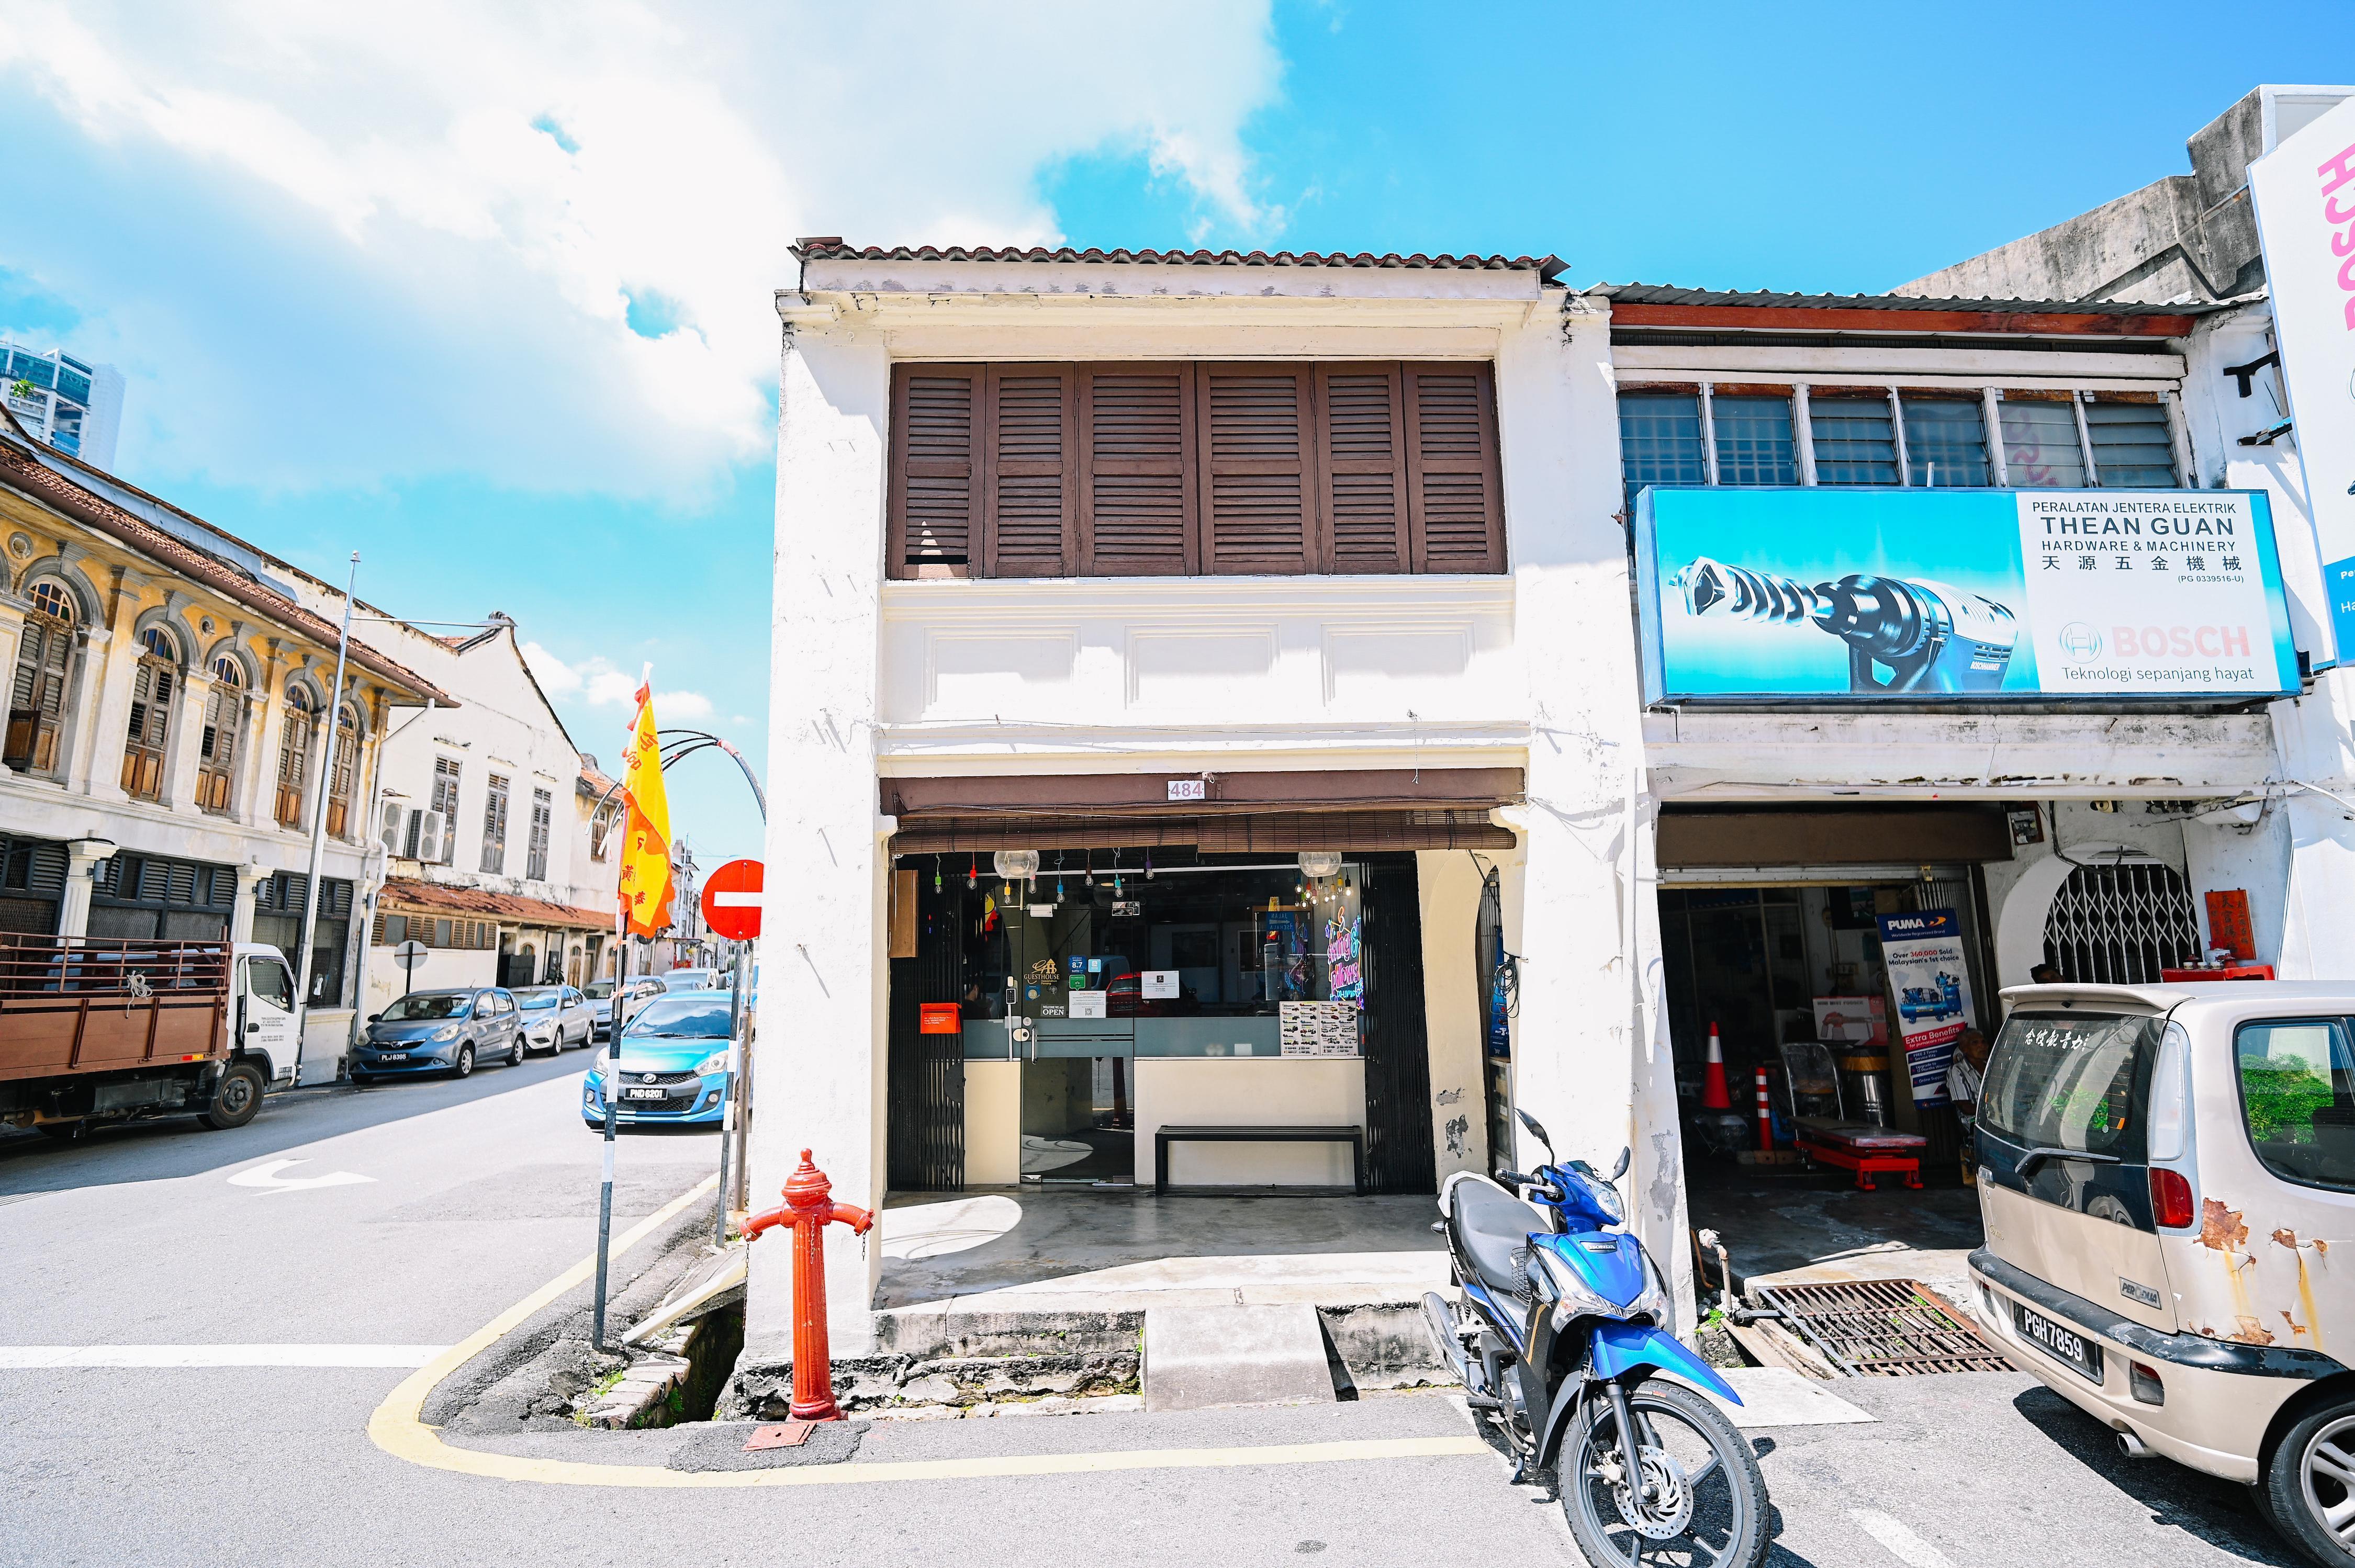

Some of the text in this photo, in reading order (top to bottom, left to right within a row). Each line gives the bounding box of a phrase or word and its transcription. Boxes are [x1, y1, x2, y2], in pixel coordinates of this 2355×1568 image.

[2033, 502, 2236, 514] PERALATAN JENTERA ELEKTRIK
[2040, 516, 2234, 536] THEAN GUAN
[2042, 540, 2236, 552] HARDWARE & MACHINERY
[2042, 555, 2242, 571] 天源五金機械
[2178, 575, 2244, 584] (PG 0339516-U)
[2112, 626, 2251, 658] BOSCH
[2061, 666, 2255, 682] Teknologi sepanjang hayat
[1170, 783, 1203, 797] 484
[1888, 918, 1925, 930] PUMA
[1905, 1026, 1959, 1045] Extra Benefits
[630, 1089, 645, 1098] PND
[1532, 1291, 1552, 1309] HONDA
